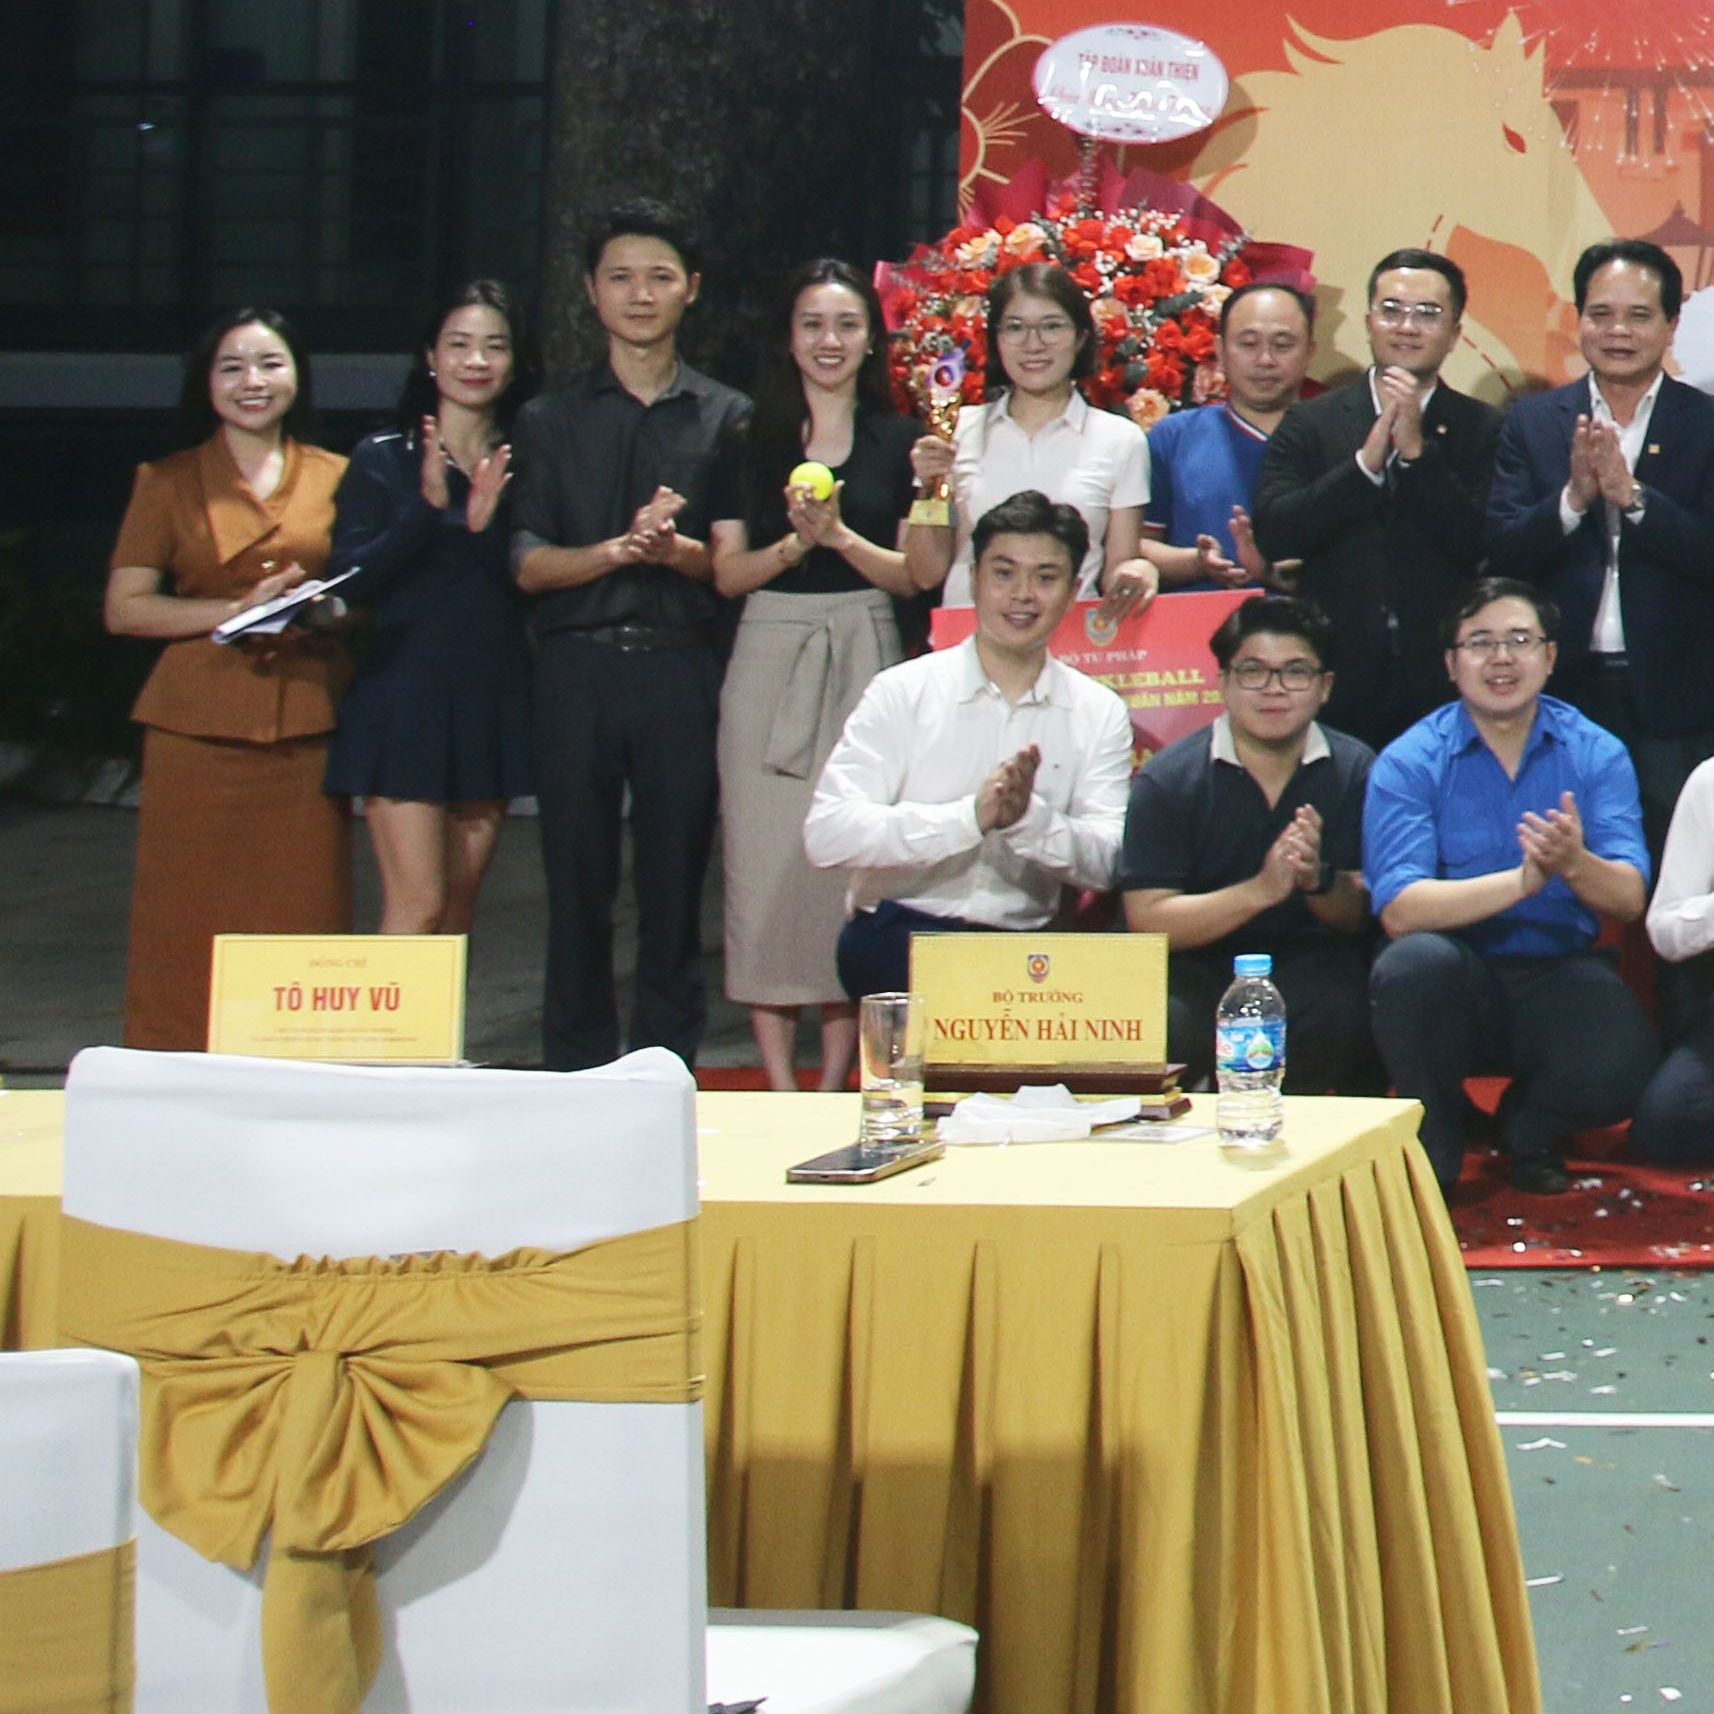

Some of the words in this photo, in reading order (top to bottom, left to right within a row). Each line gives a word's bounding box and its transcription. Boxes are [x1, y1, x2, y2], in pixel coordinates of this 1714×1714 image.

[273, 980, 303, 1011] TÔ
[312, 986, 361, 1011] HUY
[370, 981, 401, 1011] VŨ
[992, 990, 1014, 1006] BỘ
[933, 1008, 1030, 1042] NGUYỄN
[1037, 1011, 1077, 1042] HẢI
[1084, 1017, 1143, 1043] NINH
